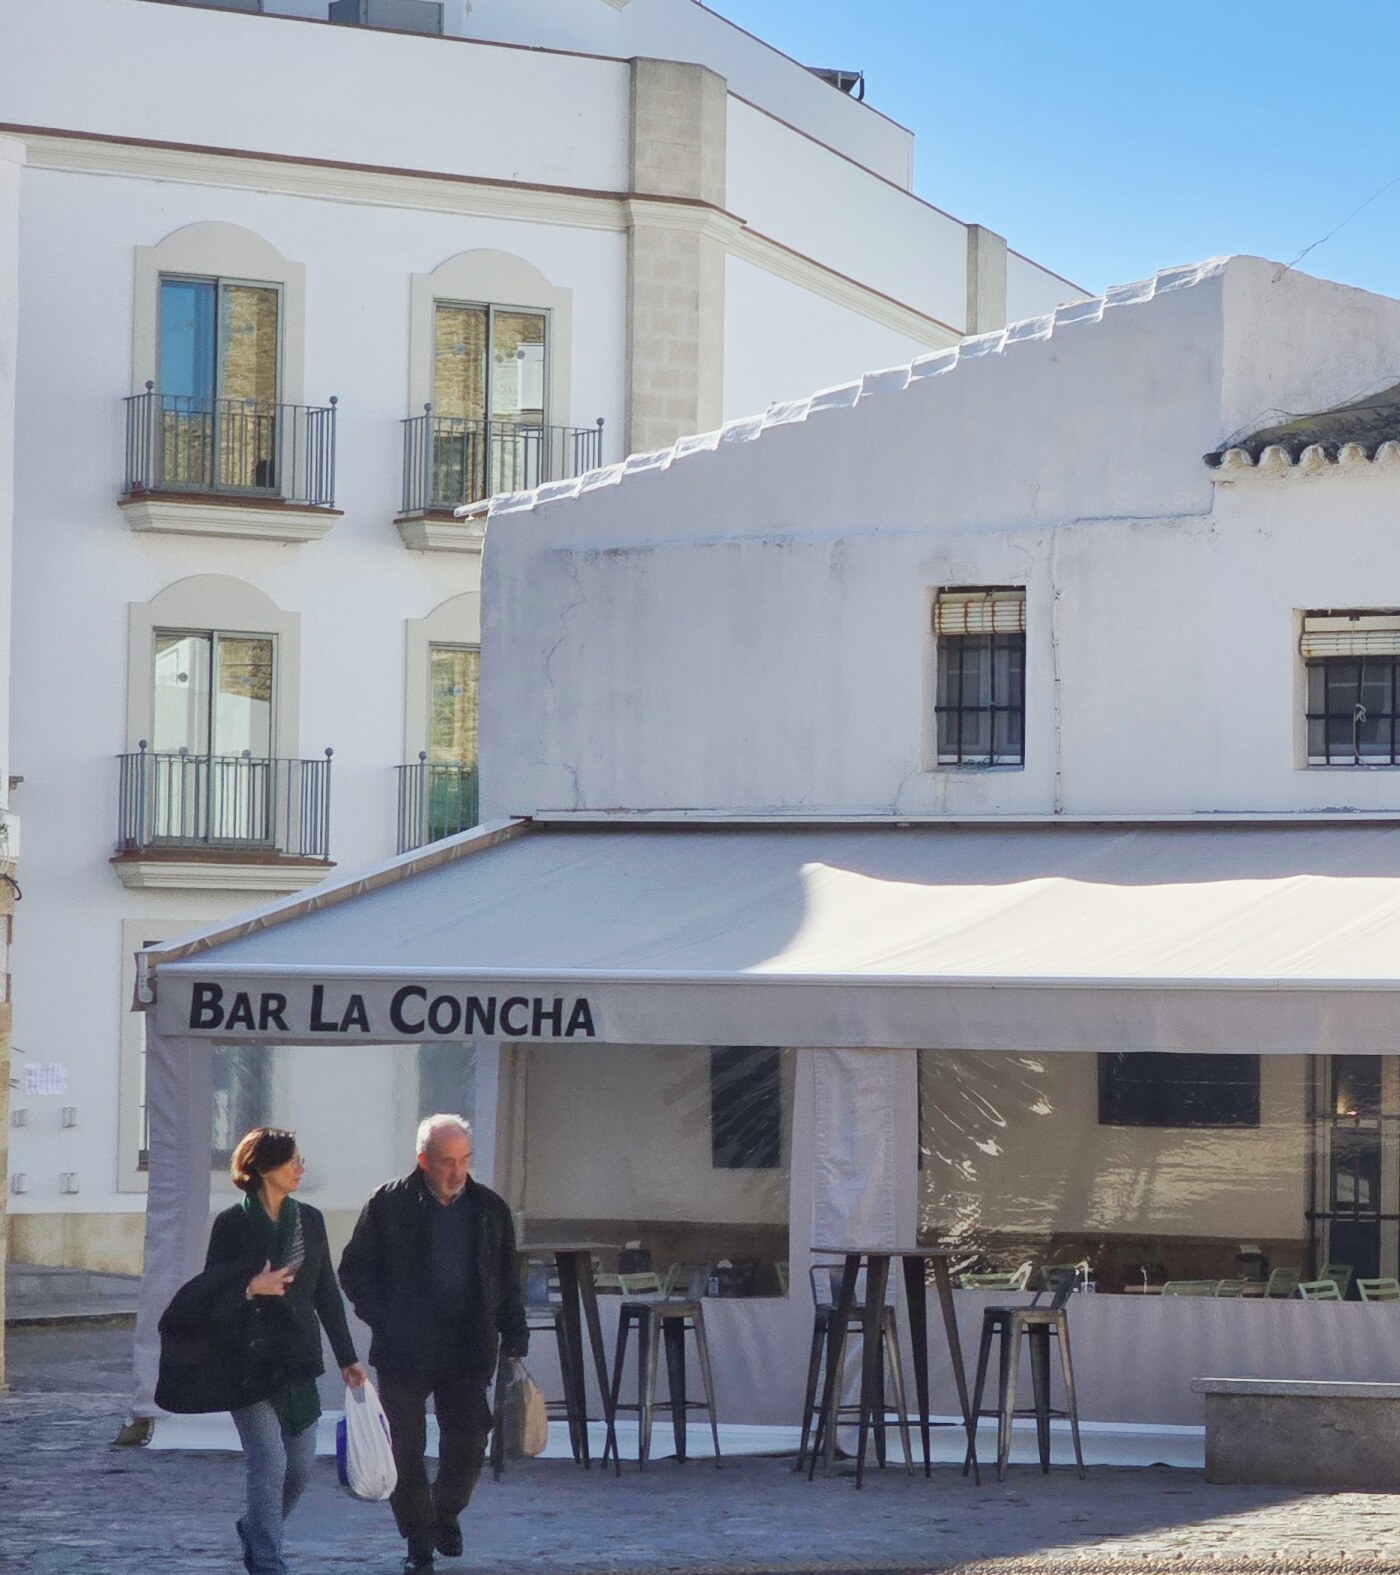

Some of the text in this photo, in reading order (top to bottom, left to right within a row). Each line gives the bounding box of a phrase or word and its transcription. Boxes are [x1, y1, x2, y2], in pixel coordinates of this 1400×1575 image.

[189, 982, 596, 1037] BAR LA CONCHA
